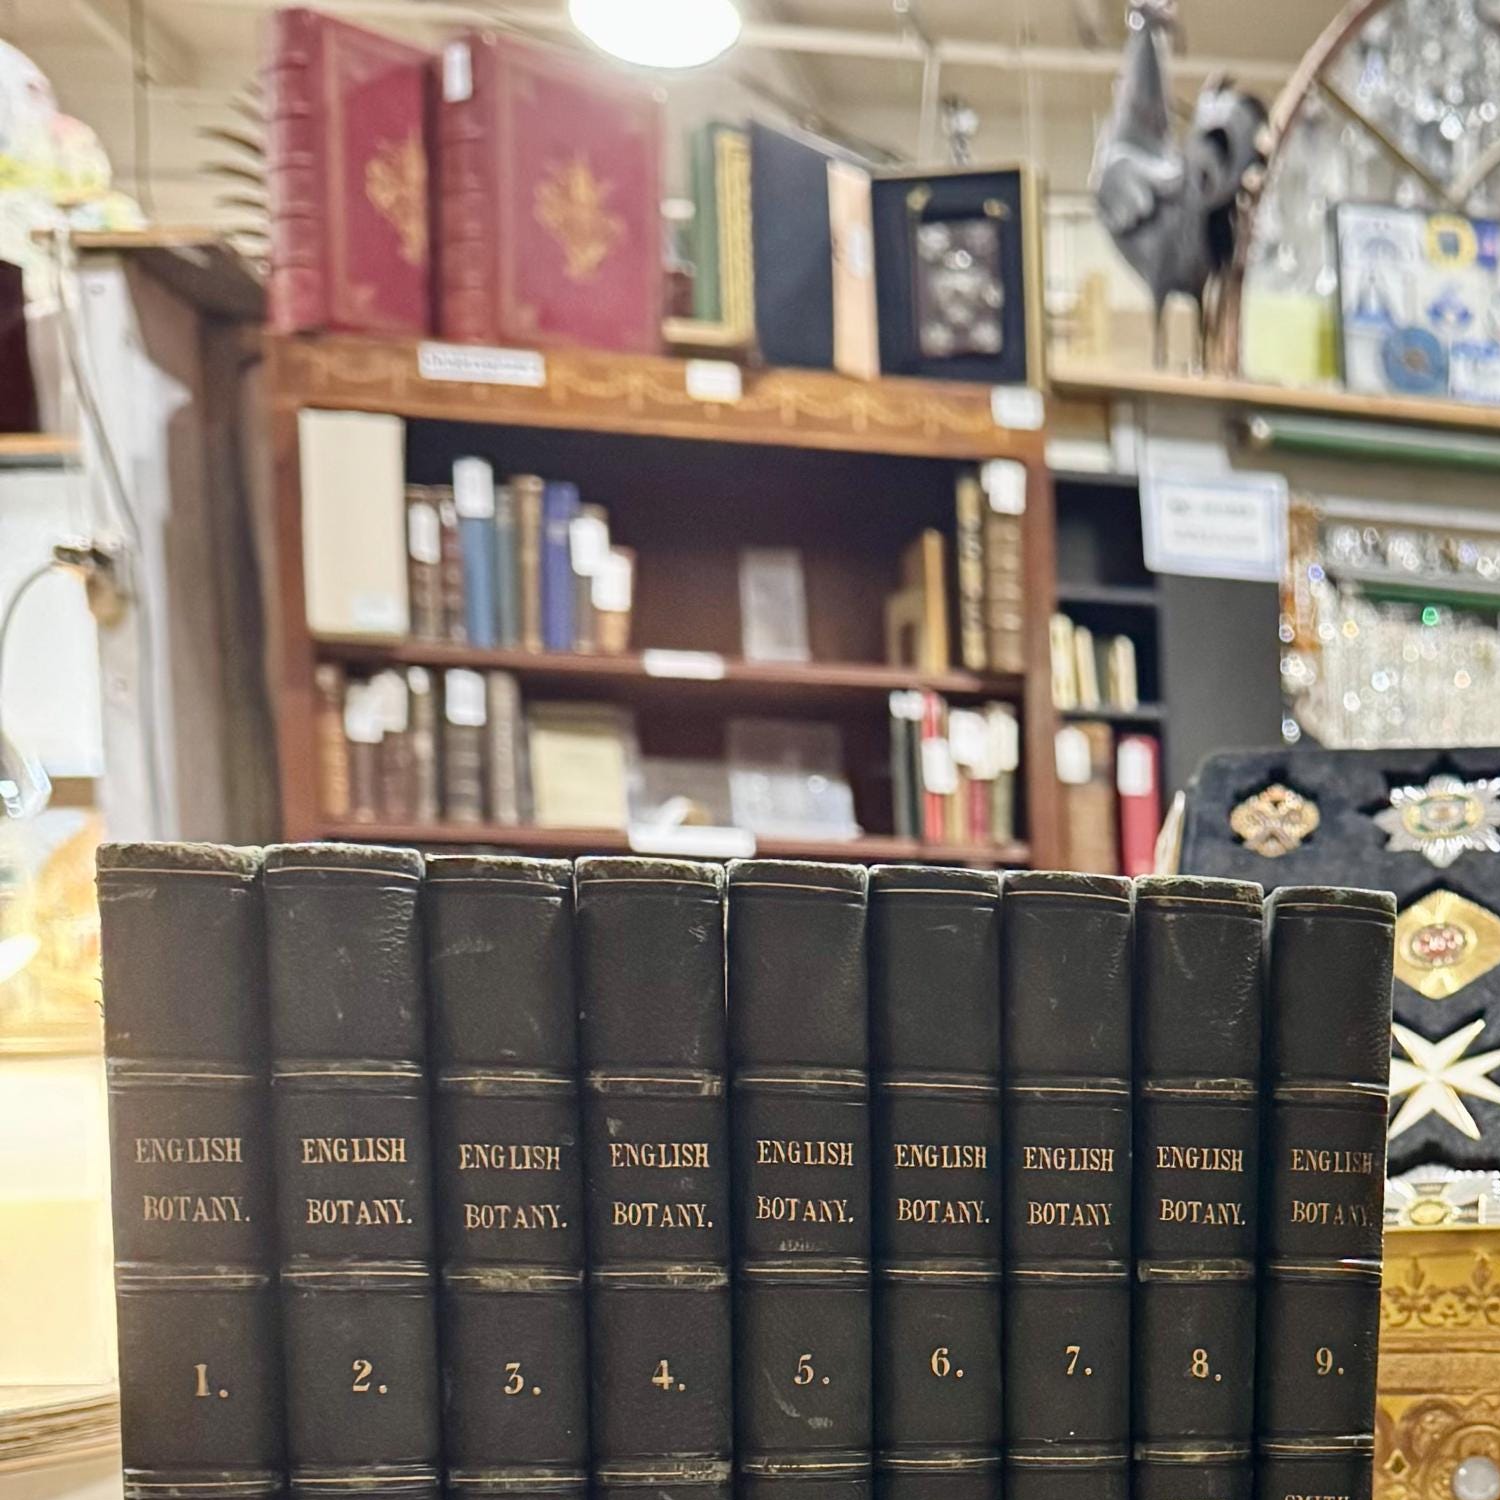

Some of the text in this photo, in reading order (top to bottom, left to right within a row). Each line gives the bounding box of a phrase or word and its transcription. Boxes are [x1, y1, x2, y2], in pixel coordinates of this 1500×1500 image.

[136, 1137, 242, 1163] ENGLISH
[302, 1138, 407, 1163] ENGLISH
[460, 1144, 561, 1170] ENGLISH
[610, 1143, 709, 1169] ENGLISH
[757, 1141, 854, 1165] ENGLISH
[895, 1144, 987, 1169] ENGLISH
[1023, 1147, 1114, 1171] ENGLISH
[1156, 1146, 1244, 1172] ENGLISH
[1290, 1149, 1373, 1174] ENGLISH
[144, 1196, 250, 1222] BOTANY.
[306, 1199, 412, 1224] BOTANY.
[465, 1204, 567, 1229] BOTANY.
[613, 1203, 713, 1227] BOTANY.
[756, 1198, 854, 1224] BOTANY.
[898, 1200, 990, 1224] BOTANY.
[1160, 1200, 1246, 1225] BOTANY.
[794, 1354, 830, 1386] 5.
[931, 1348, 964, 1378] 6.
[1066, 1346, 1092, 1376] 7.
[1191, 1349, 1221, 1382] 8.
[1316, 1347, 1344, 1375] 9.
[195, 1364, 228, 1399] 1.
[352, 1360, 387, 1394] 2.
[504, 1363, 541, 1396] 3.
[651, 1360, 686, 1391] 4.
